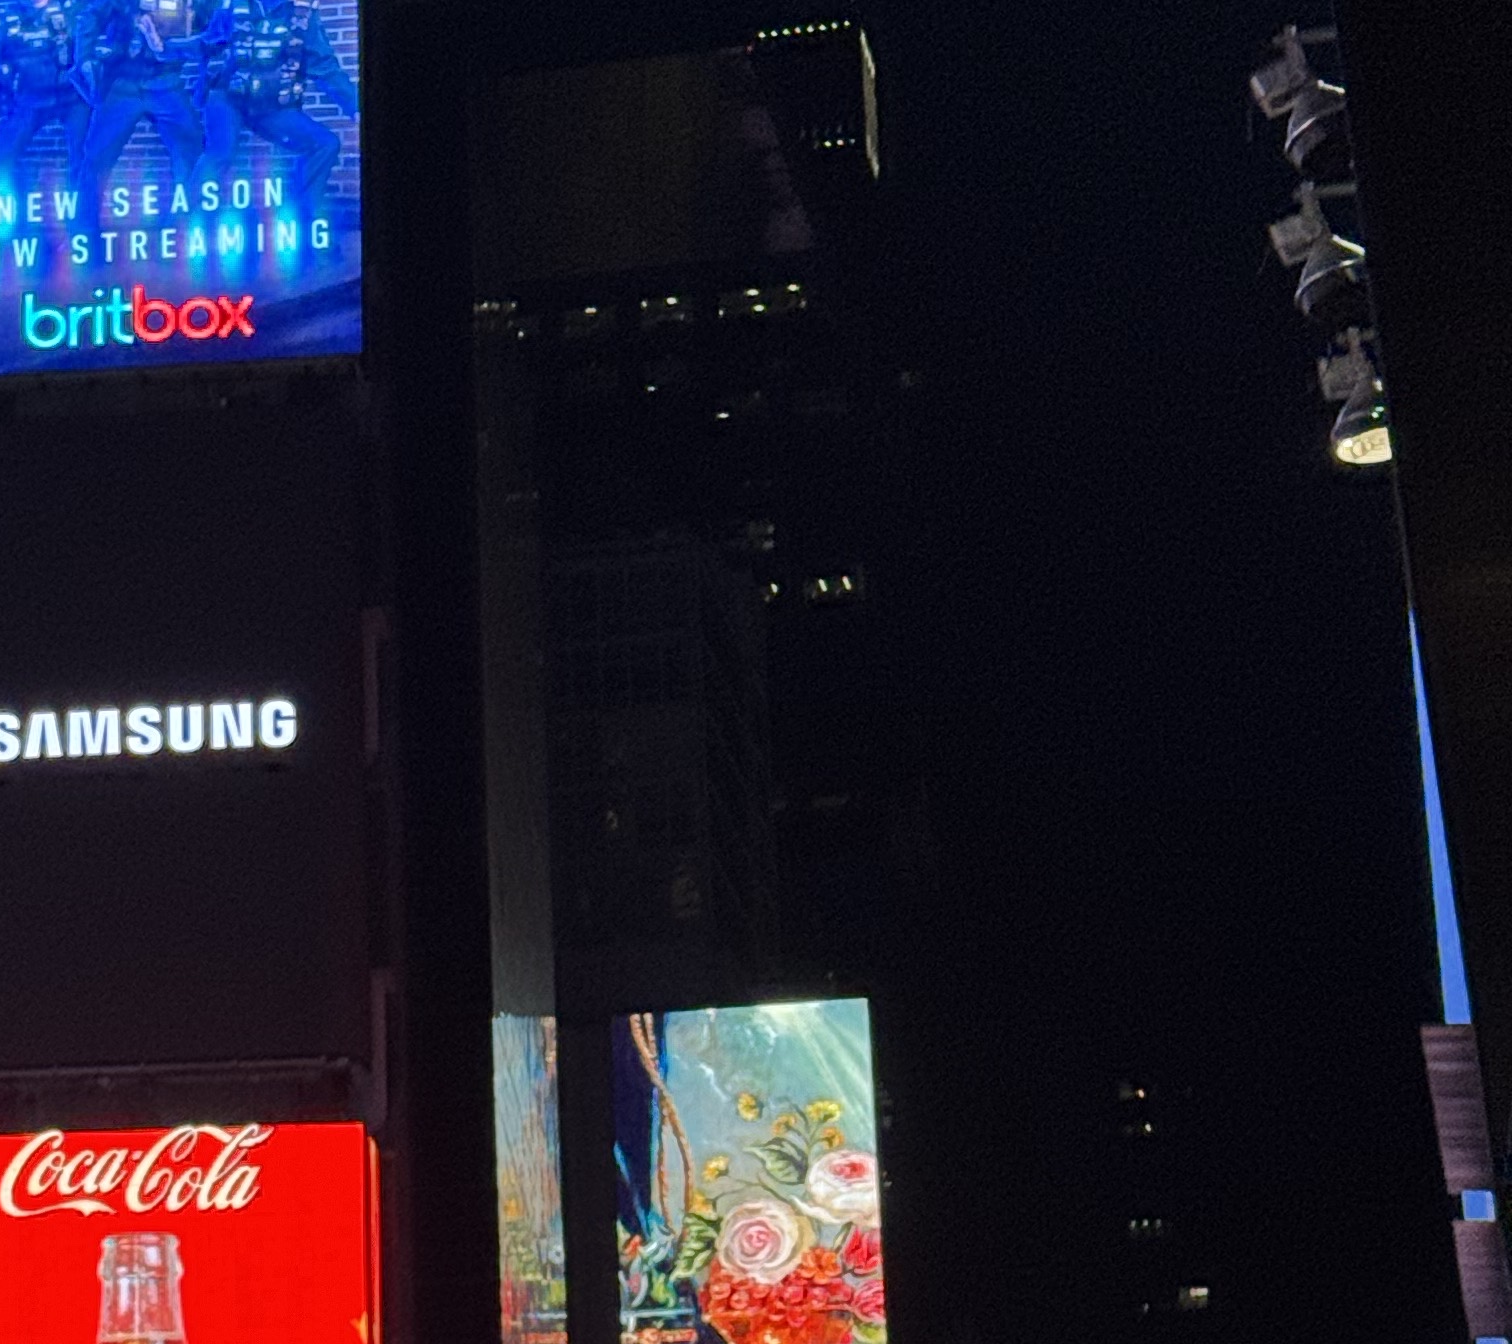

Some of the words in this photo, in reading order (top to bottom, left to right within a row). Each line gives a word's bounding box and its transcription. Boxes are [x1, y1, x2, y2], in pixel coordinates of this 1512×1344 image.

[112, 177, 284, 219] SEASON
[71, 218, 331, 266] STREAMING
[20, 284, 256, 350] britbox
